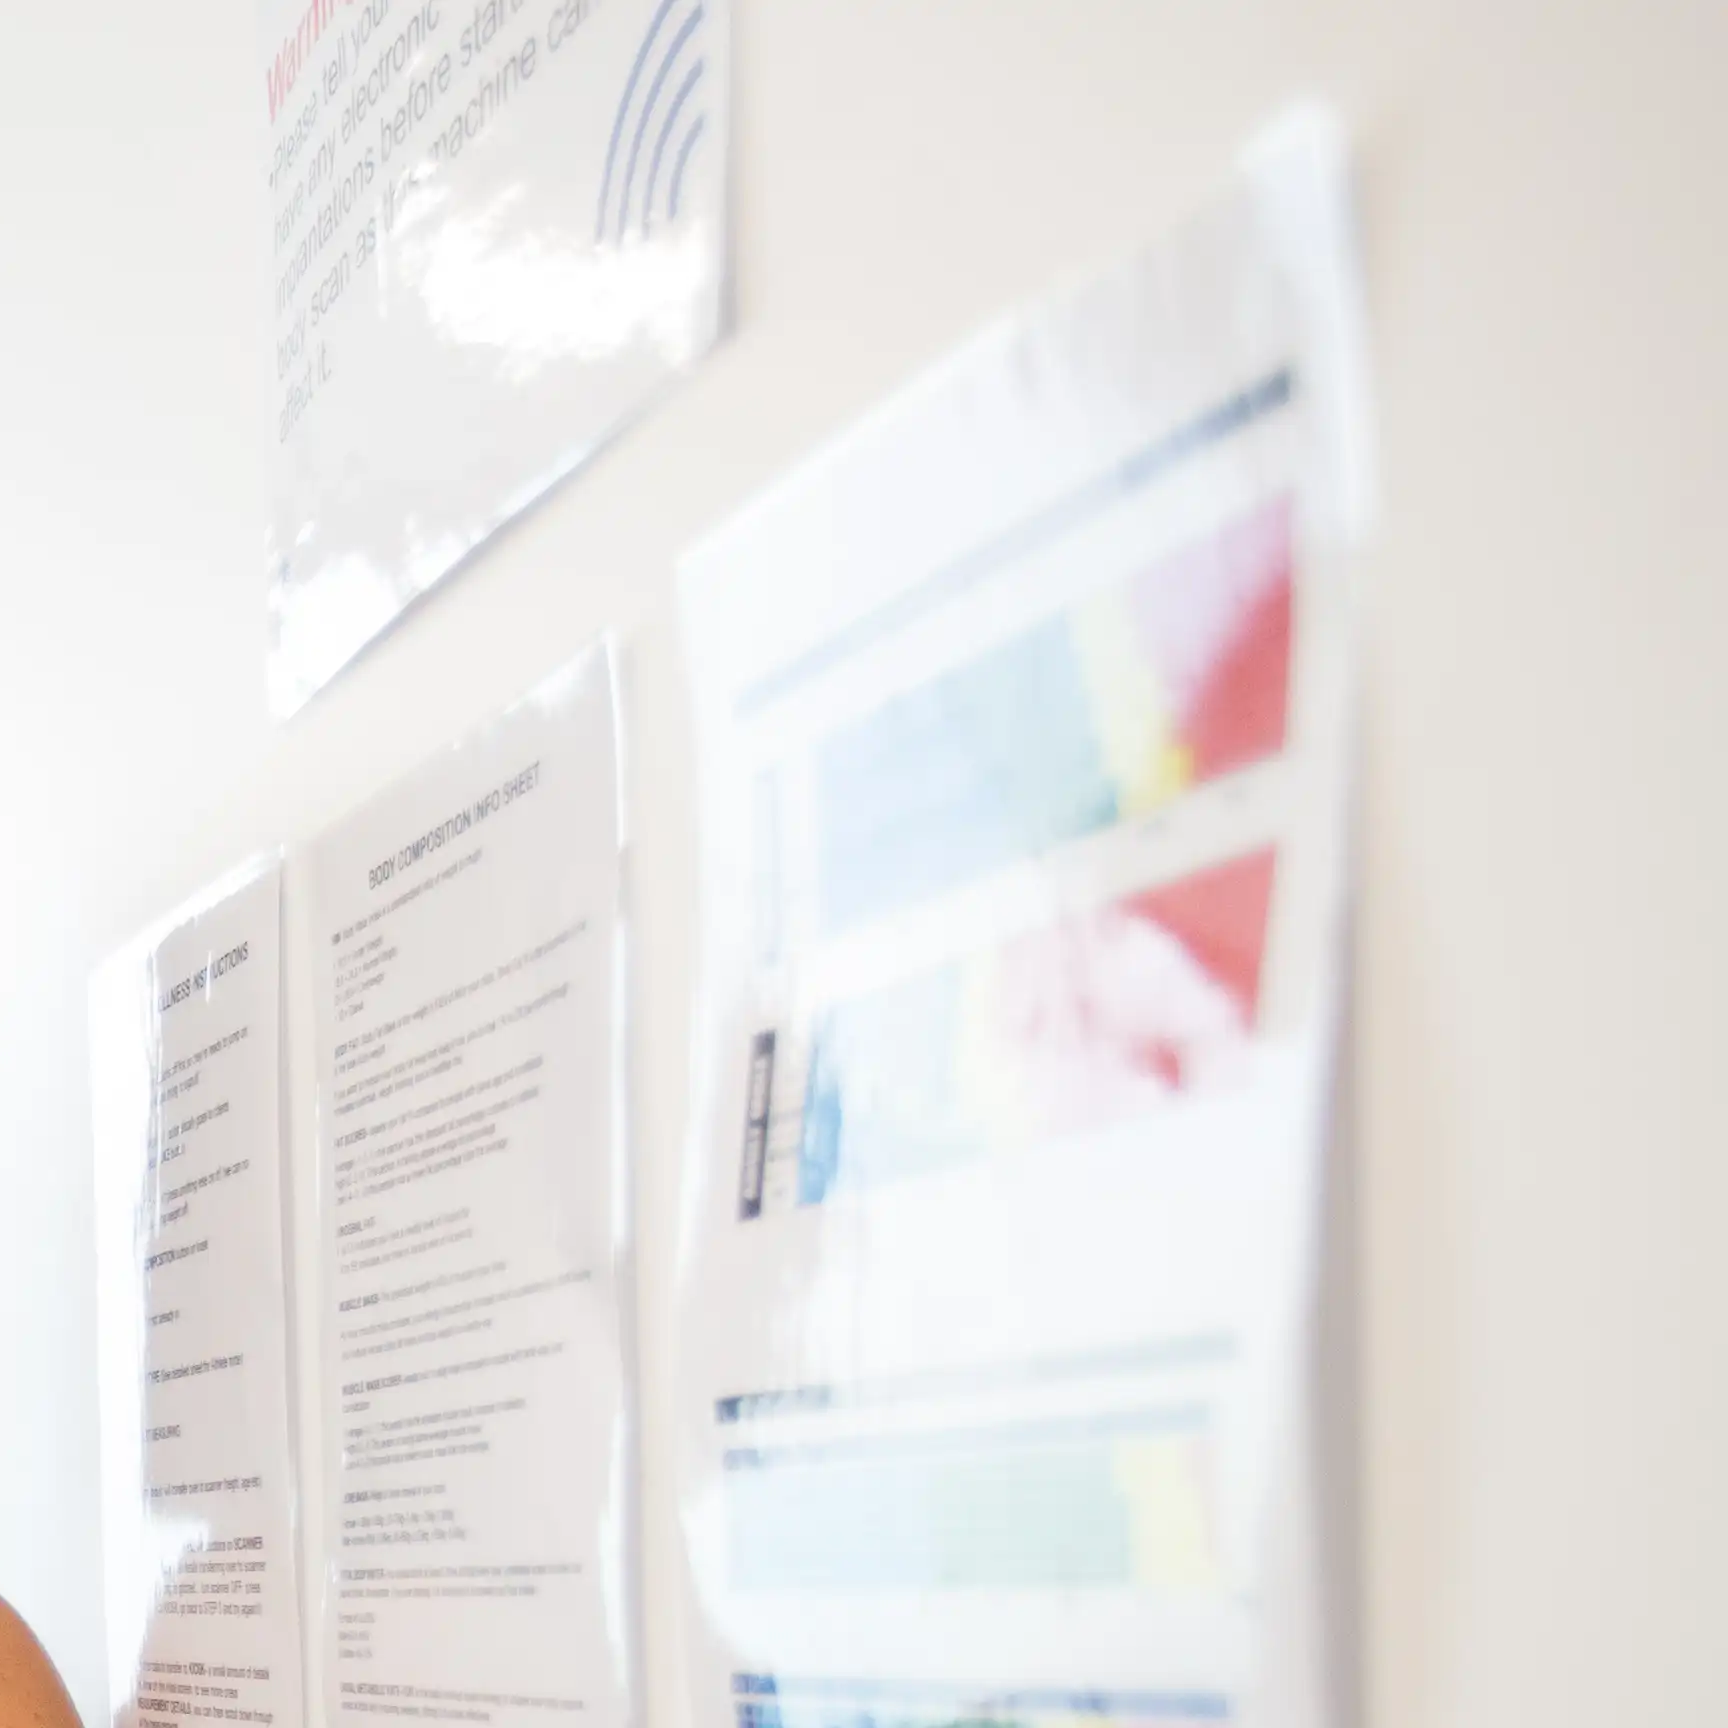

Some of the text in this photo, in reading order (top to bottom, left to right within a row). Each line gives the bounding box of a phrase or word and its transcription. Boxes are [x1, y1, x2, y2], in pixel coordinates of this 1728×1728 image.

[322, 30, 348, 105] tell
[380, 53, 451, 164] before
[274, 0, 440, 257] have any electronic
[311, 251, 351, 326] scan
[355, 215, 377, 269] as
[316, 338, 332, 385] it
[368, 760, 541, 890] BODY COMPOSITION INFO SHEET
